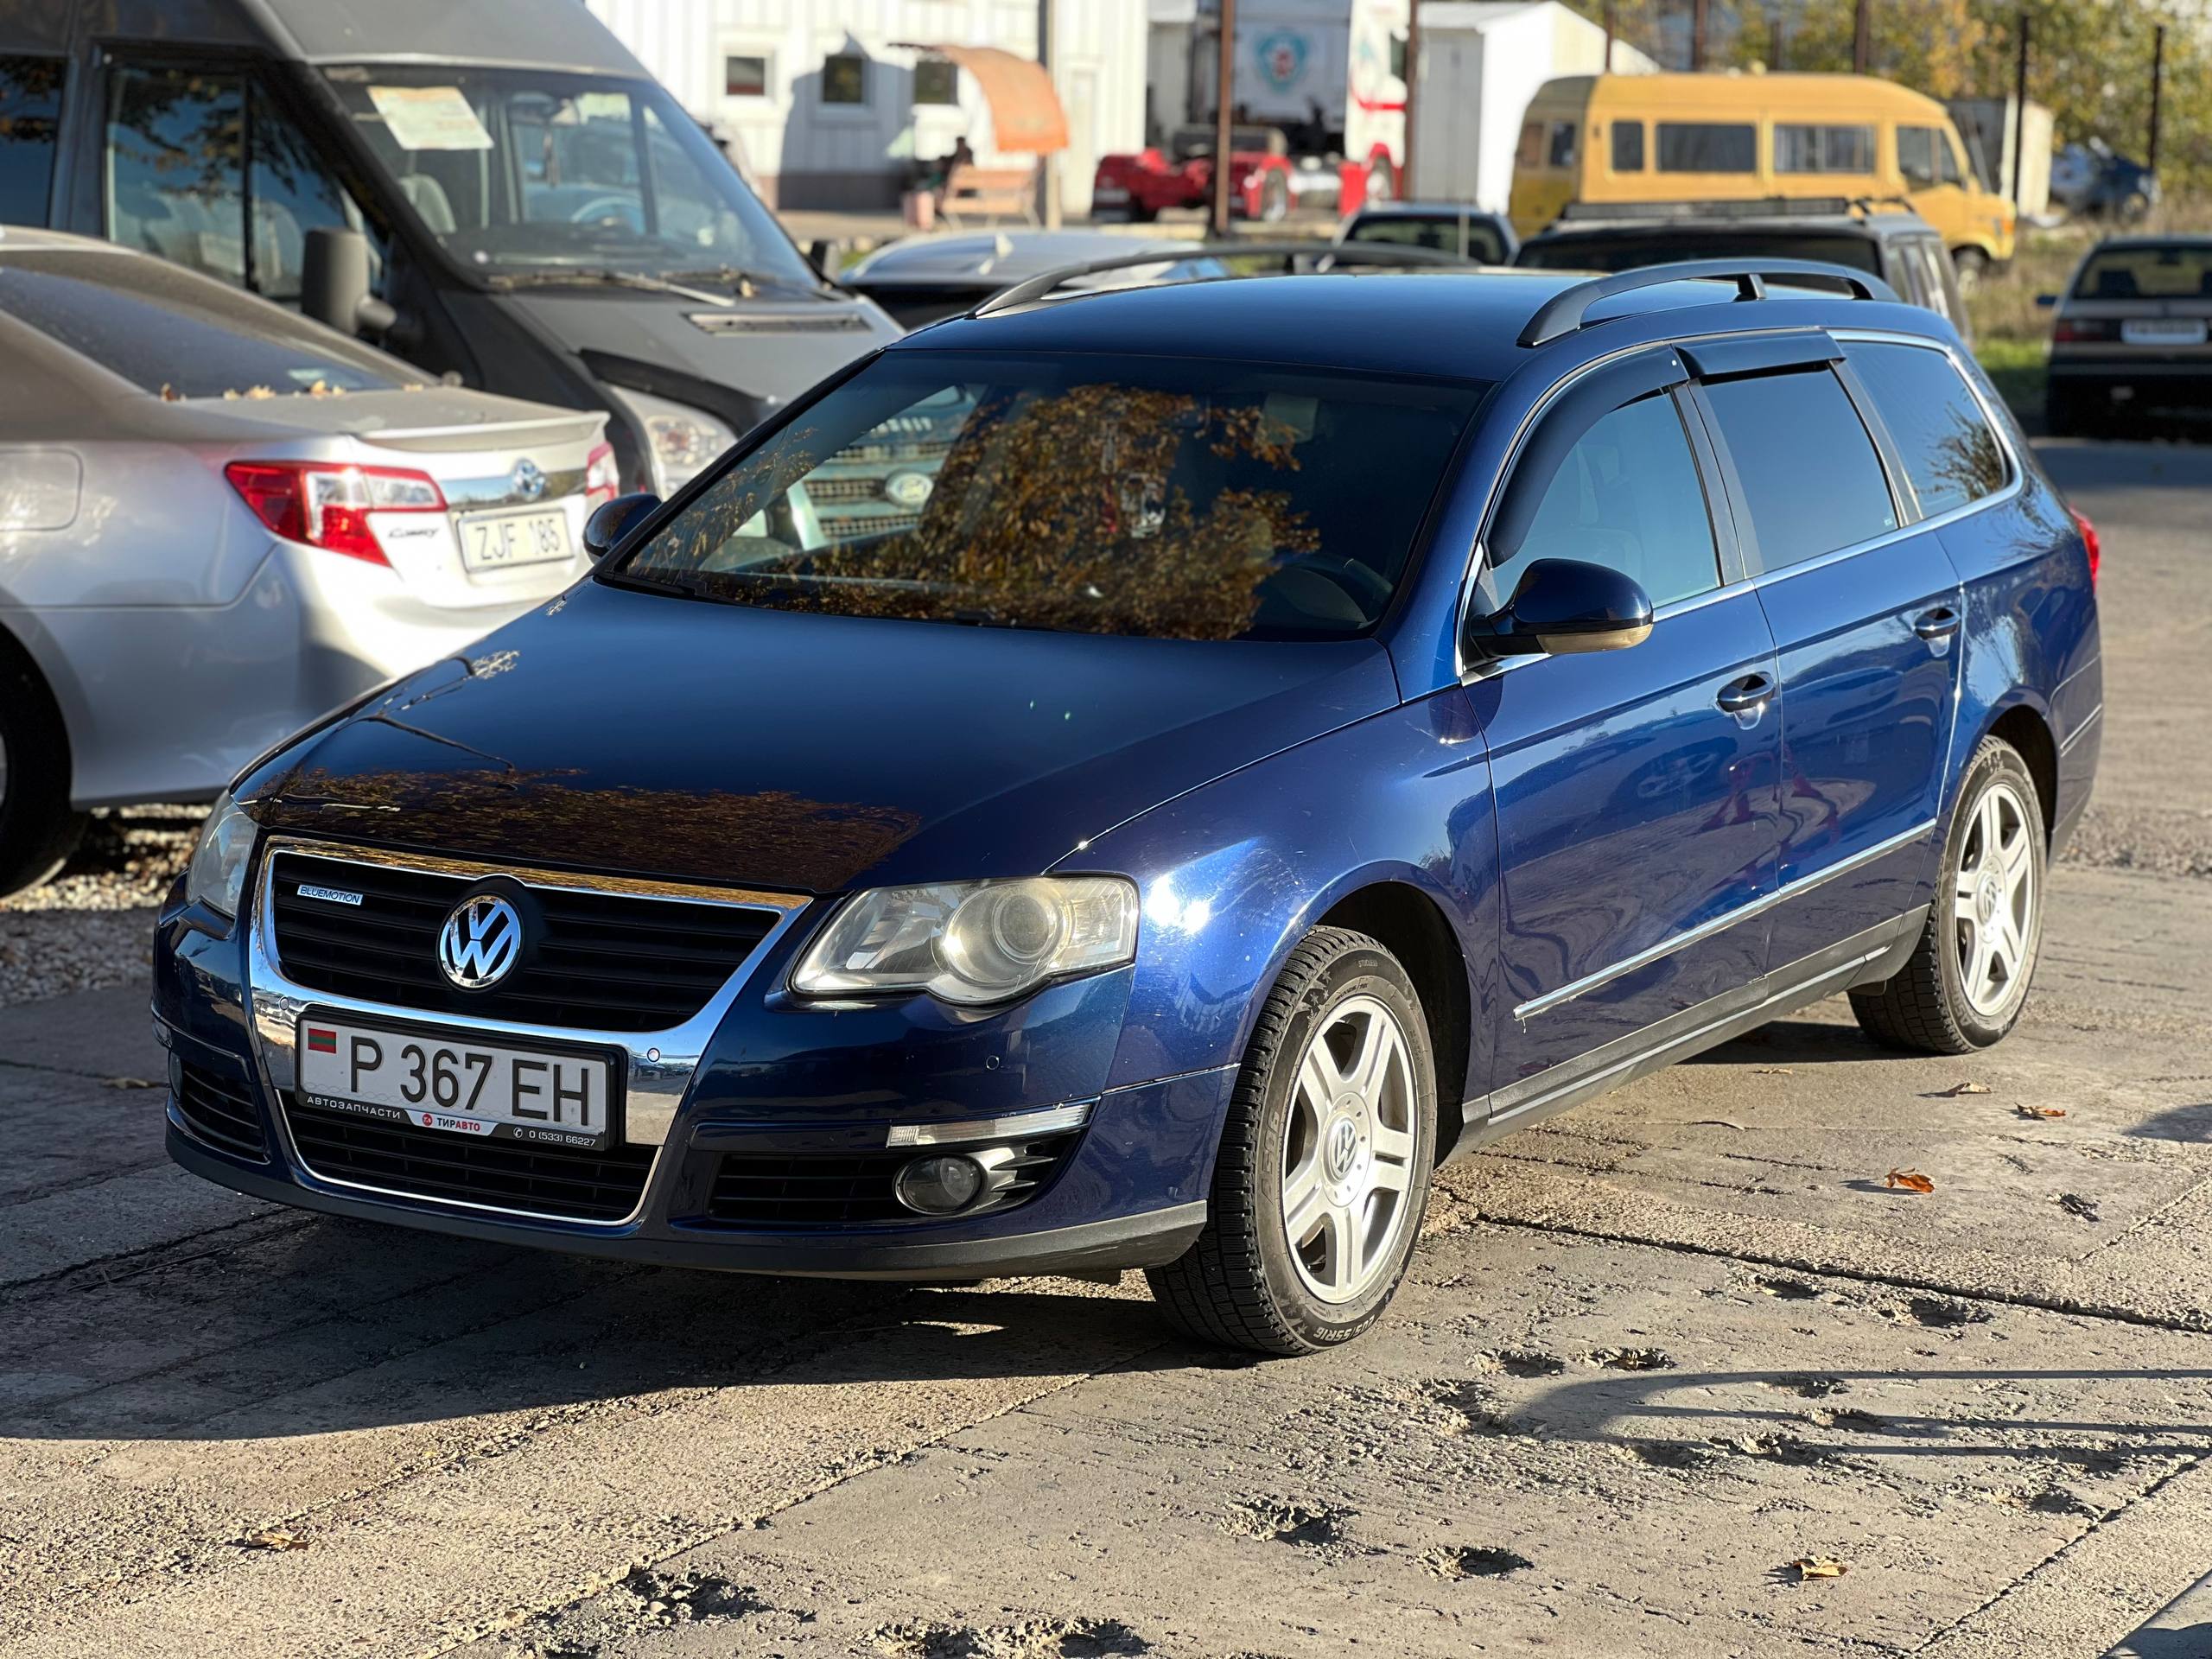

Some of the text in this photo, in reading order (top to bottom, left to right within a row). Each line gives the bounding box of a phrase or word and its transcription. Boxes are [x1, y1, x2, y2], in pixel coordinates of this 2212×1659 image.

[475, 523, 515, 561] ZJF
[300, 886, 360, 904] BLUEMOTION
[351, 1035, 589, 1127] P 367 EH
[307, 1096, 401, 1121] АВТОЗАПЧАСТИ
[436, 1117, 480, 1132] ТИРАВТО
[529, 1130, 597, 1147] 0 (533) 66227
